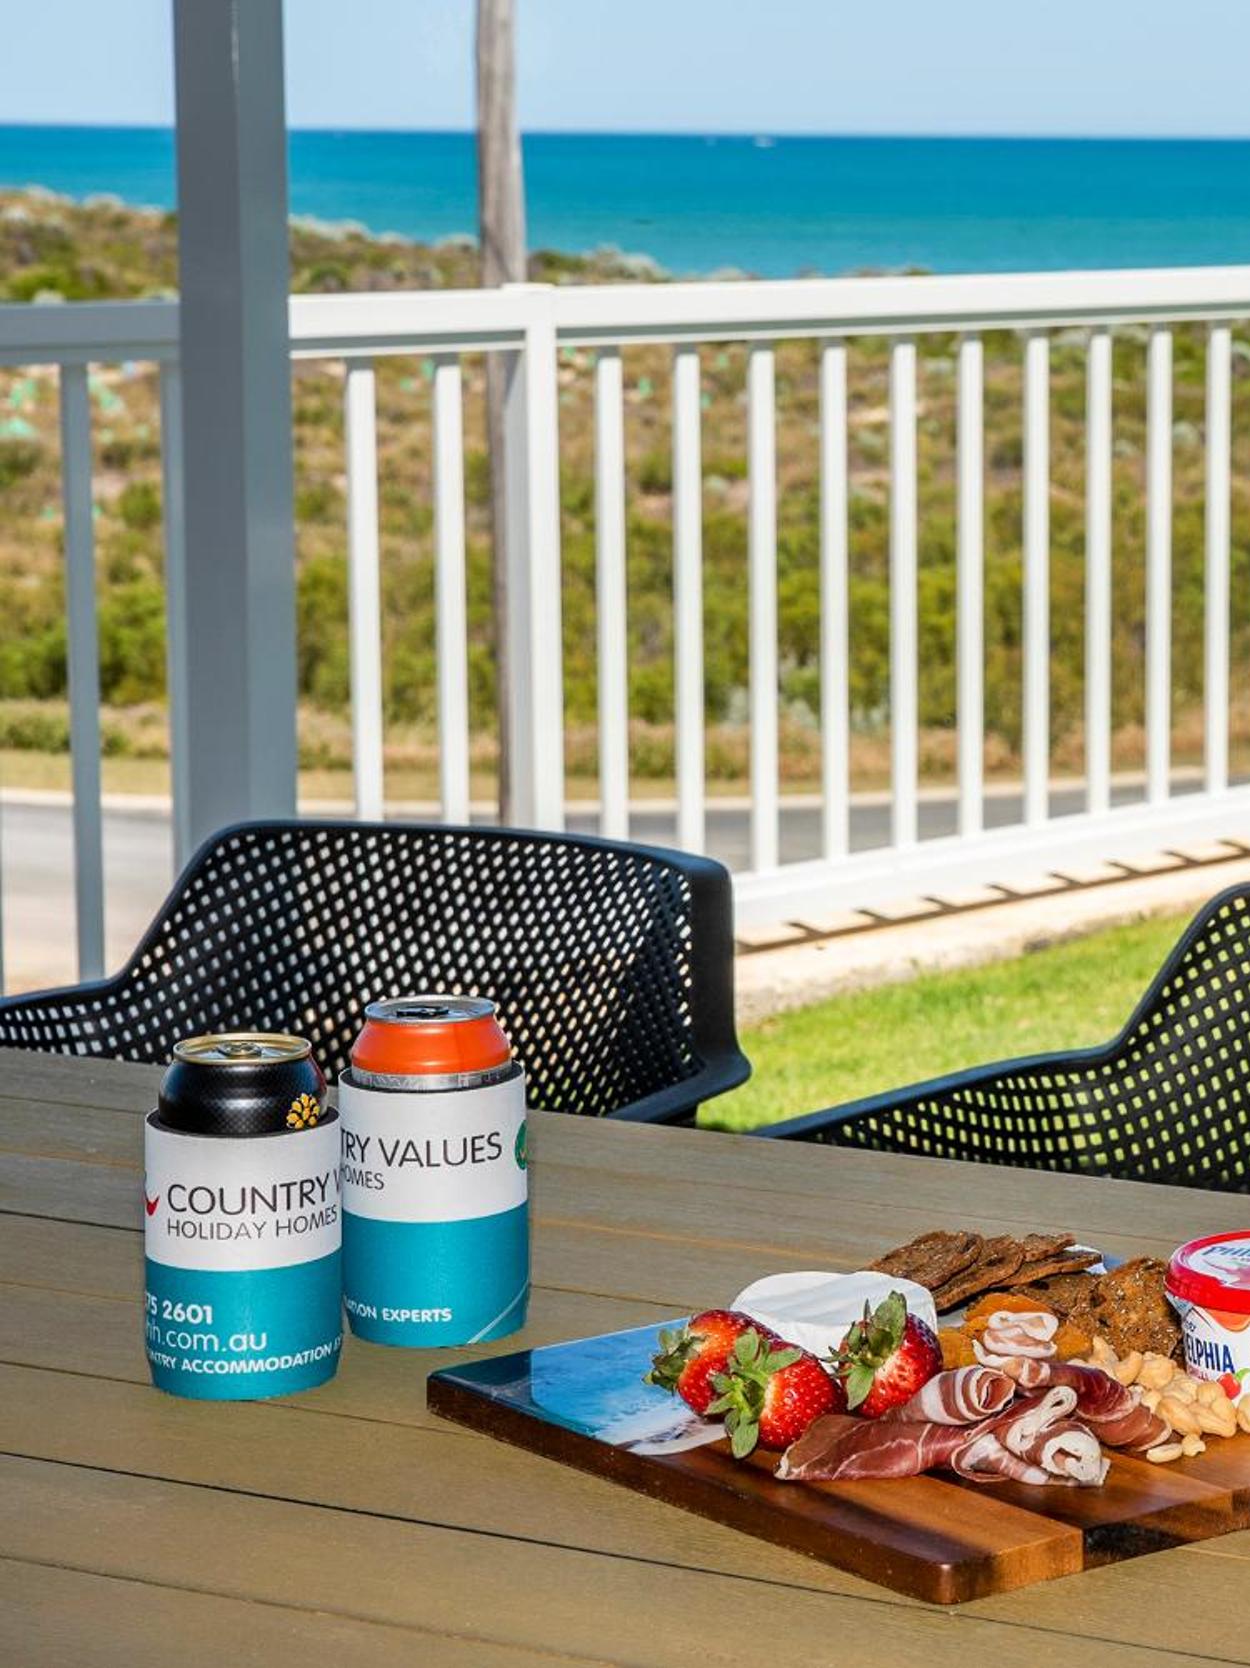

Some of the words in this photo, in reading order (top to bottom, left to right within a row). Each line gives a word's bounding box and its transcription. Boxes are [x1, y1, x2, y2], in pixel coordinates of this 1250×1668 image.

[378, 1131, 502, 1168] VALUES
[167, 1172, 330, 1216] COUNTRY
[167, 1217, 267, 1241] HOLIDAY
[275, 1203, 338, 1238] HOMES
[162, 1299, 214, 1325] 2601
[382, 1306, 453, 1323] EXPERTS
[181, 1341, 332, 1375] ACCOMMODATION
